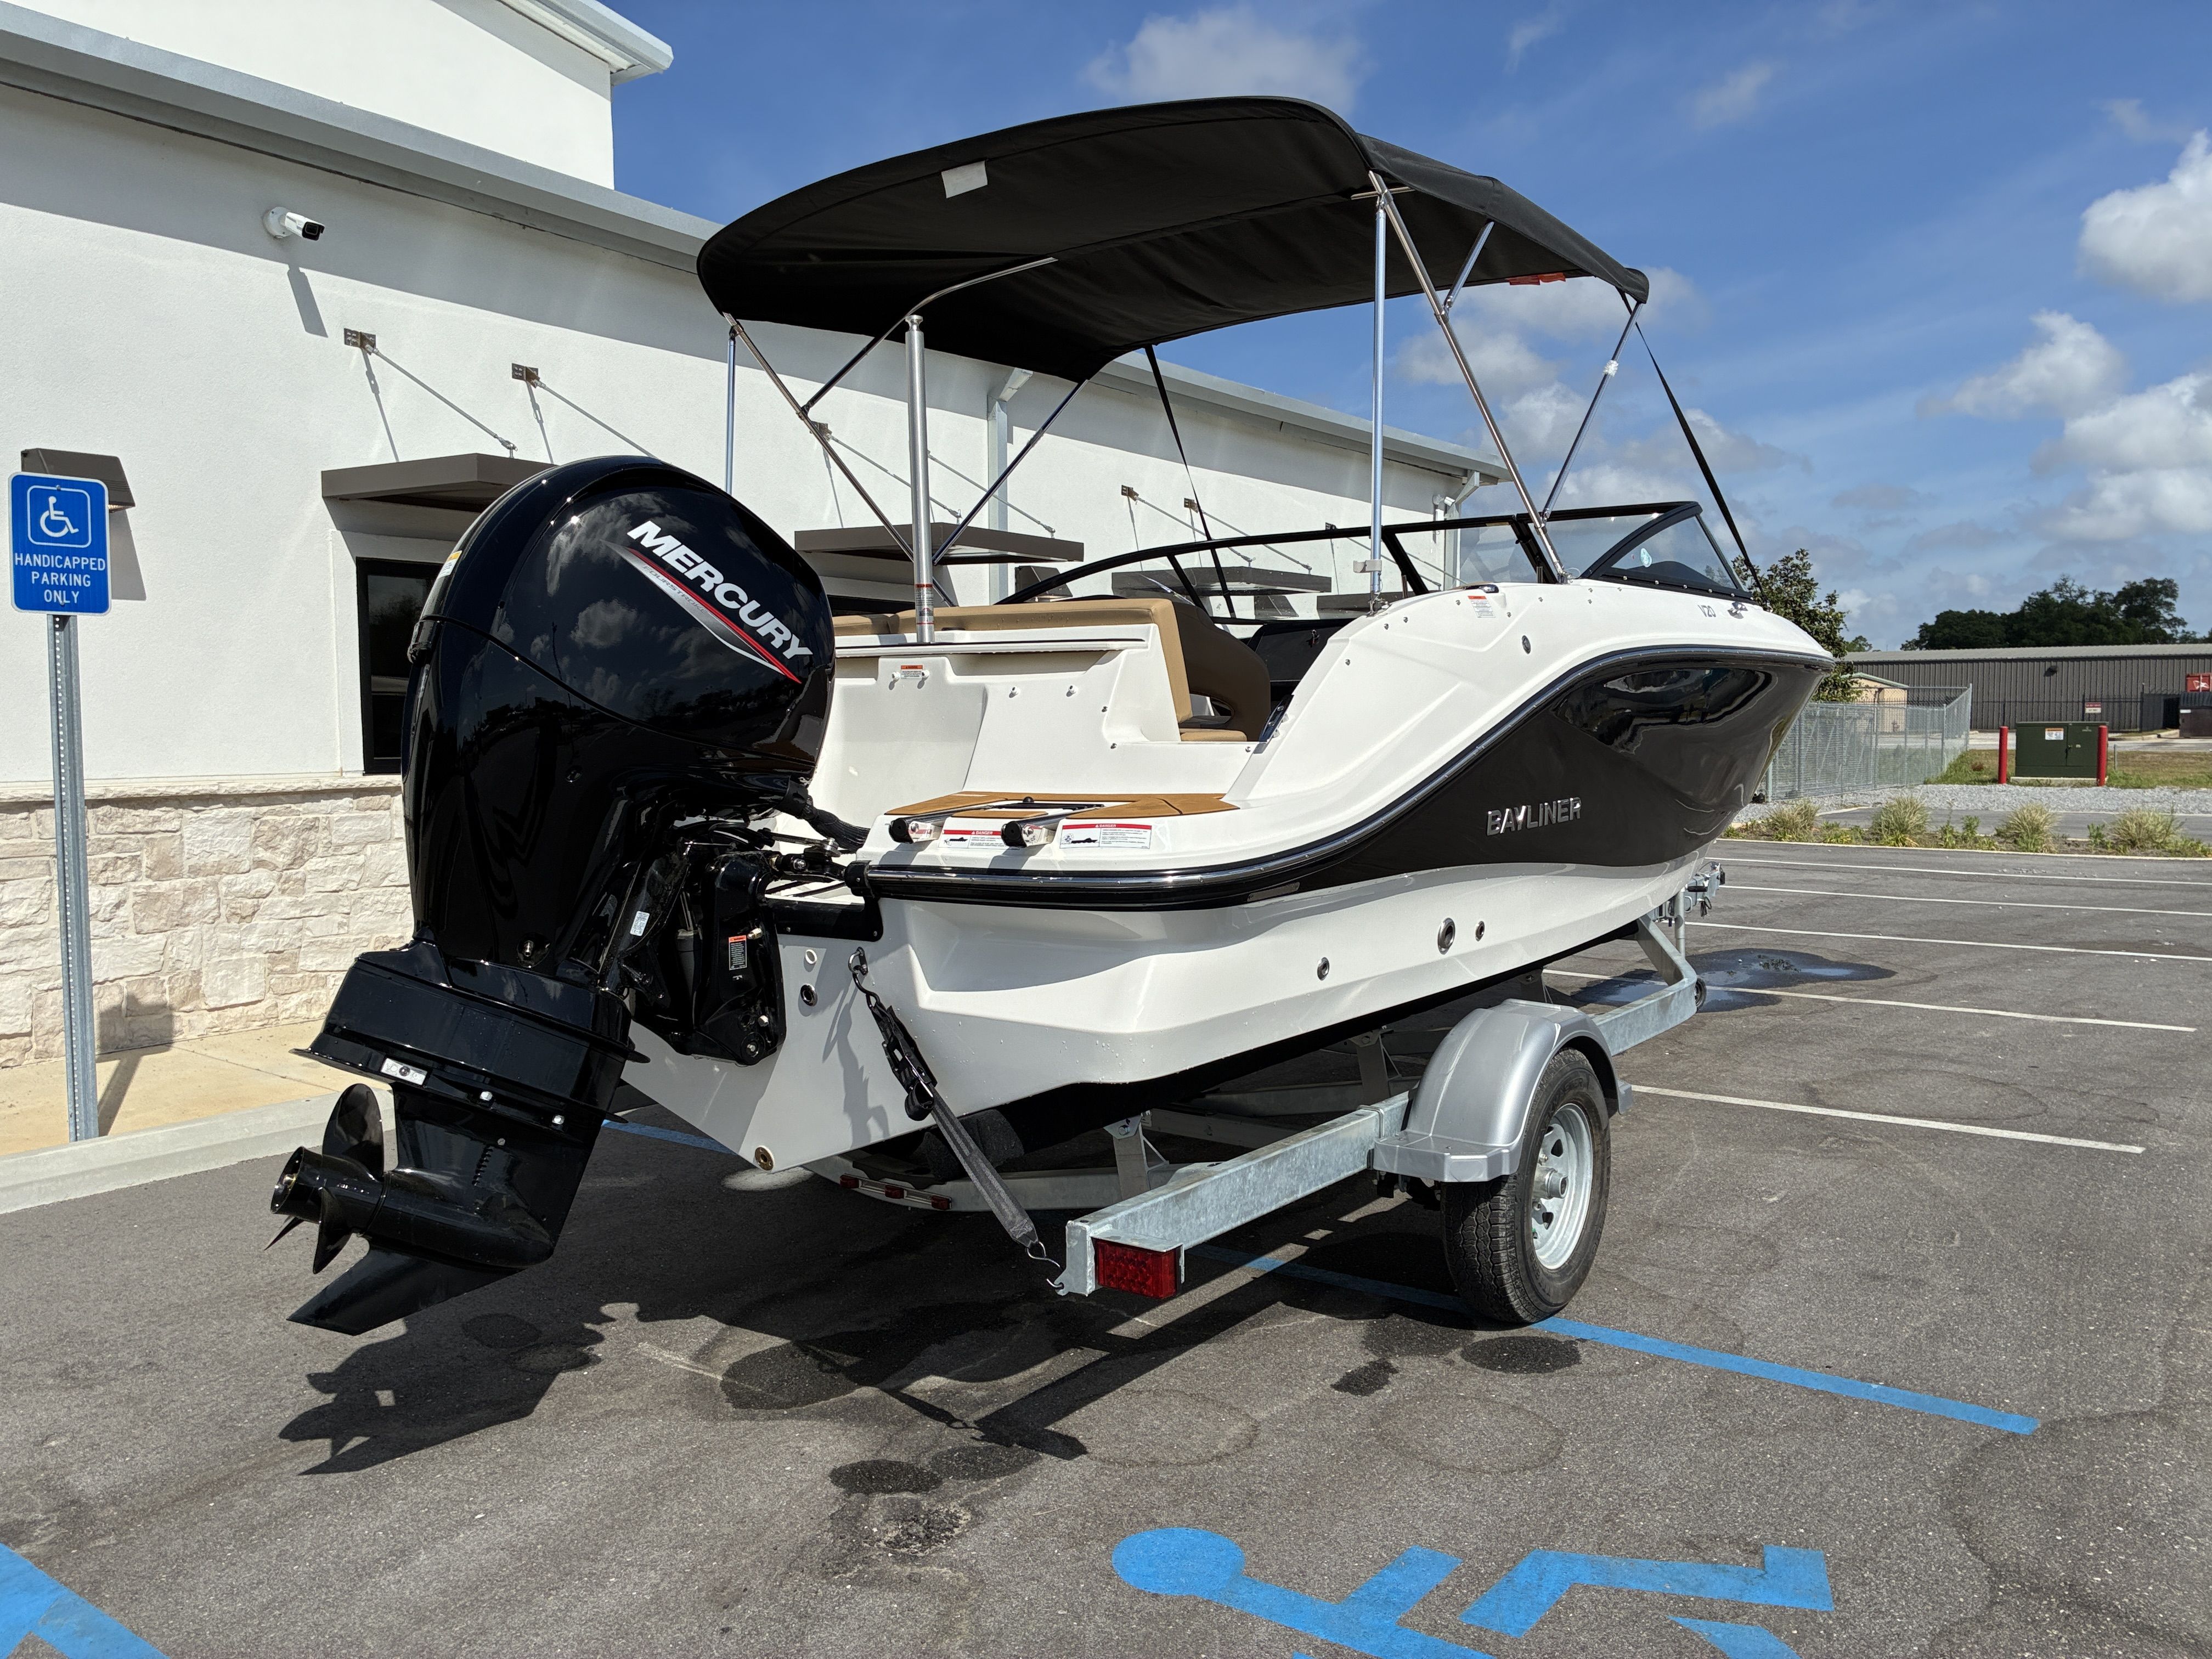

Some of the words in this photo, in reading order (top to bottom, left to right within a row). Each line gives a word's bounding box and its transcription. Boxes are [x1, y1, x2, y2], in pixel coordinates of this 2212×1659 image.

[15, 552, 106, 572] HANDICAPPED
[32, 571, 91, 587] PARKING
[627, 521, 813, 659] MERCURY
[642, 566, 708, 614] FOURSTROKE
[44, 590, 80, 604] ONLY
[1487, 797, 1582, 836] BAYLINER
